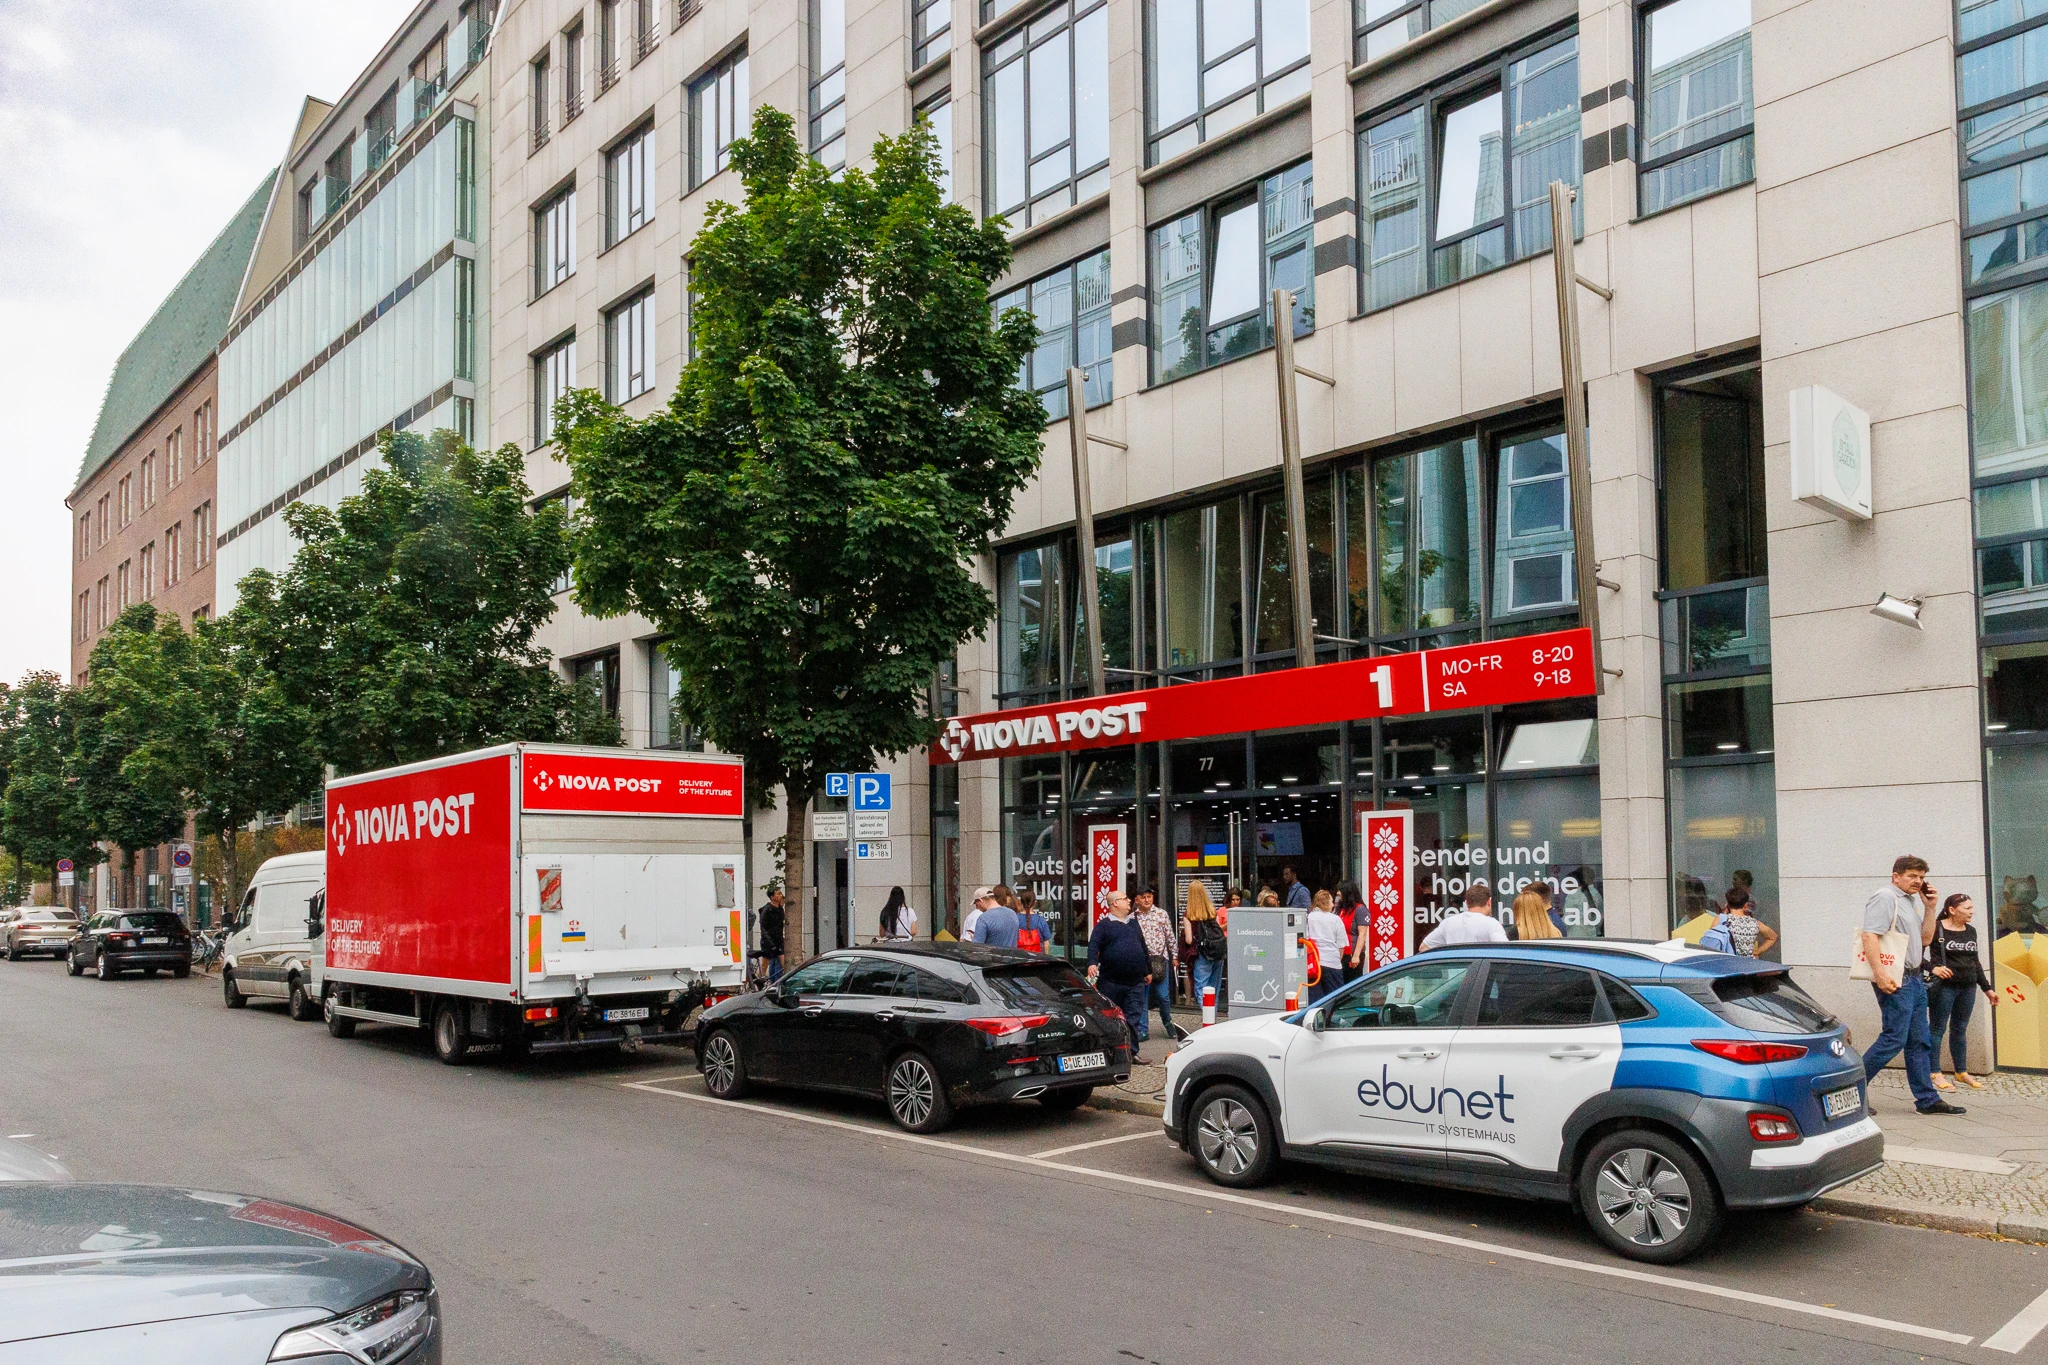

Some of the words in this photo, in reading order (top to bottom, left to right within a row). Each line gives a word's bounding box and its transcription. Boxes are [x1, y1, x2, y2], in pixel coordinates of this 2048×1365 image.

[1442, 655, 1503, 677] MO-FR
[1532, 645, 1573, 665] 8-20
[1370, 665, 1394, 708] 1
[1442, 681, 1467, 697] SA
[1533, 669, 1572, 687] 9-18
[971, 715, 1056, 751] NOVA
[1056, 702, 1147, 742] POST
[1199, 757, 1214, 771] 77
[558, 775, 610, 791] NOVA
[614, 777, 661, 793] POST
[679, 780, 713, 788] DELIVERY
[831, 776, 844, 793] P
[860, 778, 880, 806] P
[354, 803, 410, 845] NOVA
[413, 792, 475, 839] POST
[1413, 843, 1487, 867] Sende
[1496, 841, 1549, 865] und
[1564, 902, 1601, 926] ab
[331, 919, 363, 933] DELIVERY
[1237, 928, 1273, 936] Ladestation
[331, 938, 340, 952] OF
[342, 939, 353, 953] THE
[355, 940, 380, 955] FUTURE
[1880, 953, 1895, 961] OVA
[608, 1010, 619, 1019] AC
[620, 1009, 636, 1018] 3816
[1357, 1064, 1515, 1123] ebunet
[1425, 1123, 1435, 1133] IT
[1438, 1124, 1516, 1144] SYSTEMHAUS
